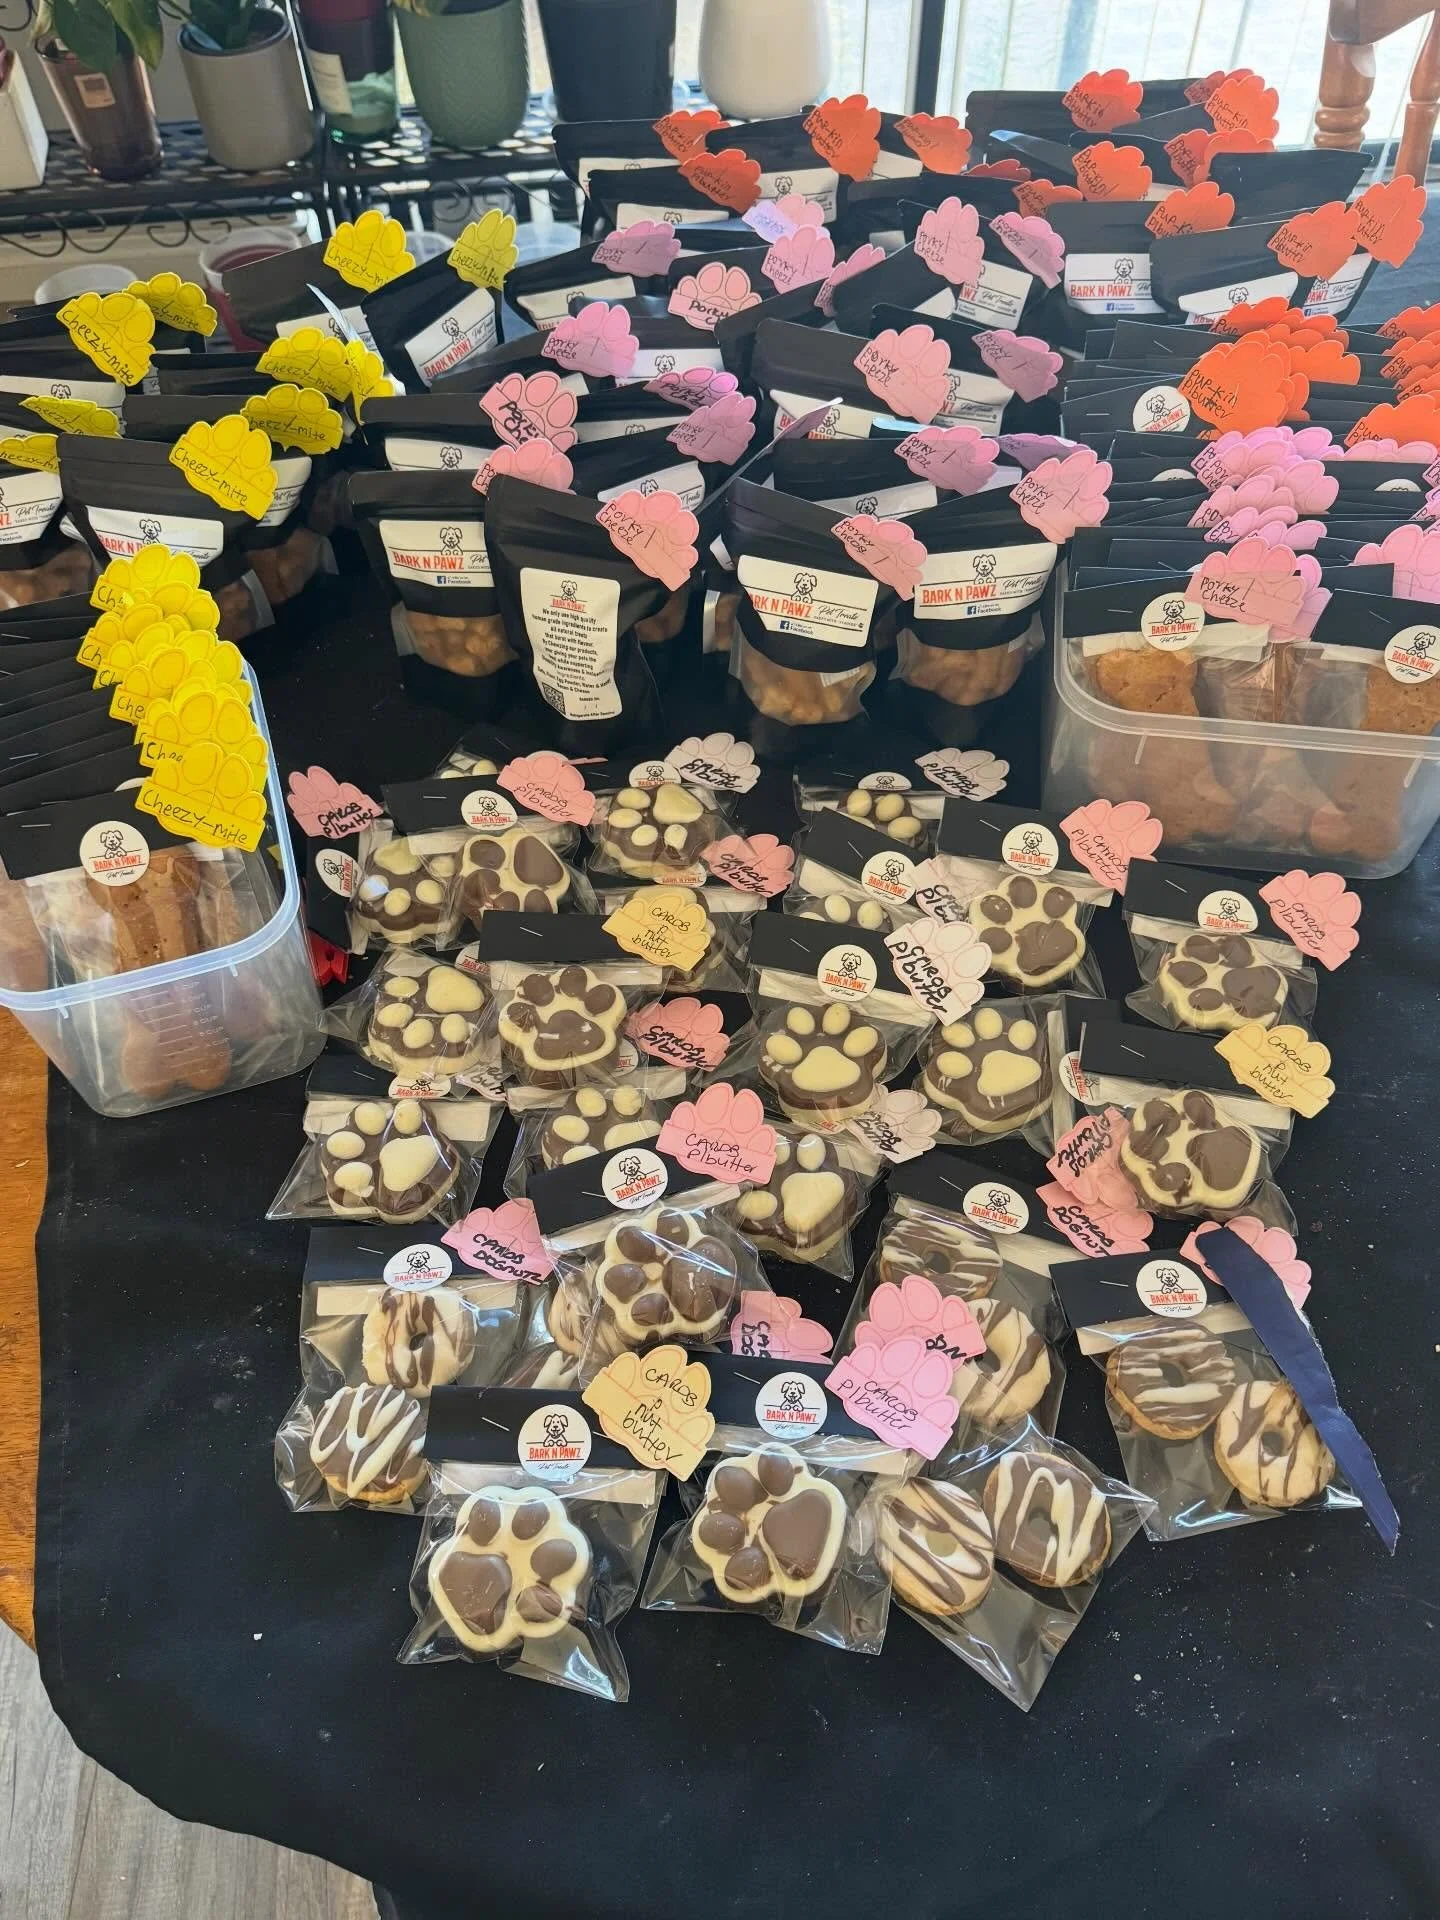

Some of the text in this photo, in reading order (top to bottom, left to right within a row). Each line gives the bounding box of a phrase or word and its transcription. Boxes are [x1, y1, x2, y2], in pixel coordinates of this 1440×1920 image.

[1071, 285, 1096, 297] BARK
[1108, 285, 1132, 297] PAWZ
[393, 551, 464, 570] BARK N PAWZ
[922, 585, 997, 604] BARK N PAWZ
[771, 598, 815, 618] N PAWZ
[1151, 625, 1170, 635] BARK
[1178, 623, 1198, 632] PAWZ
[1392, 650, 1409, 664] BARK
[1416, 659, 1434, 671] PAWZ
[93, 859, 113, 871] BARK
[120, 855, 143, 867] PAWZ
[1011, 852, 1027, 863] BARK
[1034, 855, 1050, 865] PAWZ
[868, 875, 885, 889] BARK
[890, 884, 907, 897] PAWZ
[825, 973, 843, 985] BARK
[850, 980, 867, 991] PAWZ
[615, 1186, 635, 1199] BARK
[642, 1175, 661, 1188] PAWZ
[972, 1206, 990, 1218] BARK
[998, 1213, 1018, 1226] PAWZ
[1151, 1295, 1170, 1304] BARK
[1178, 1293, 1198, 1302] PAWZ
[864, 1380, 919, 1422] CAROB
[766, 1410, 787, 1421] BARK
[796, 1412, 817, 1423] PAWZ
[529, 1447, 581, 1459] BARK N PAWZ
